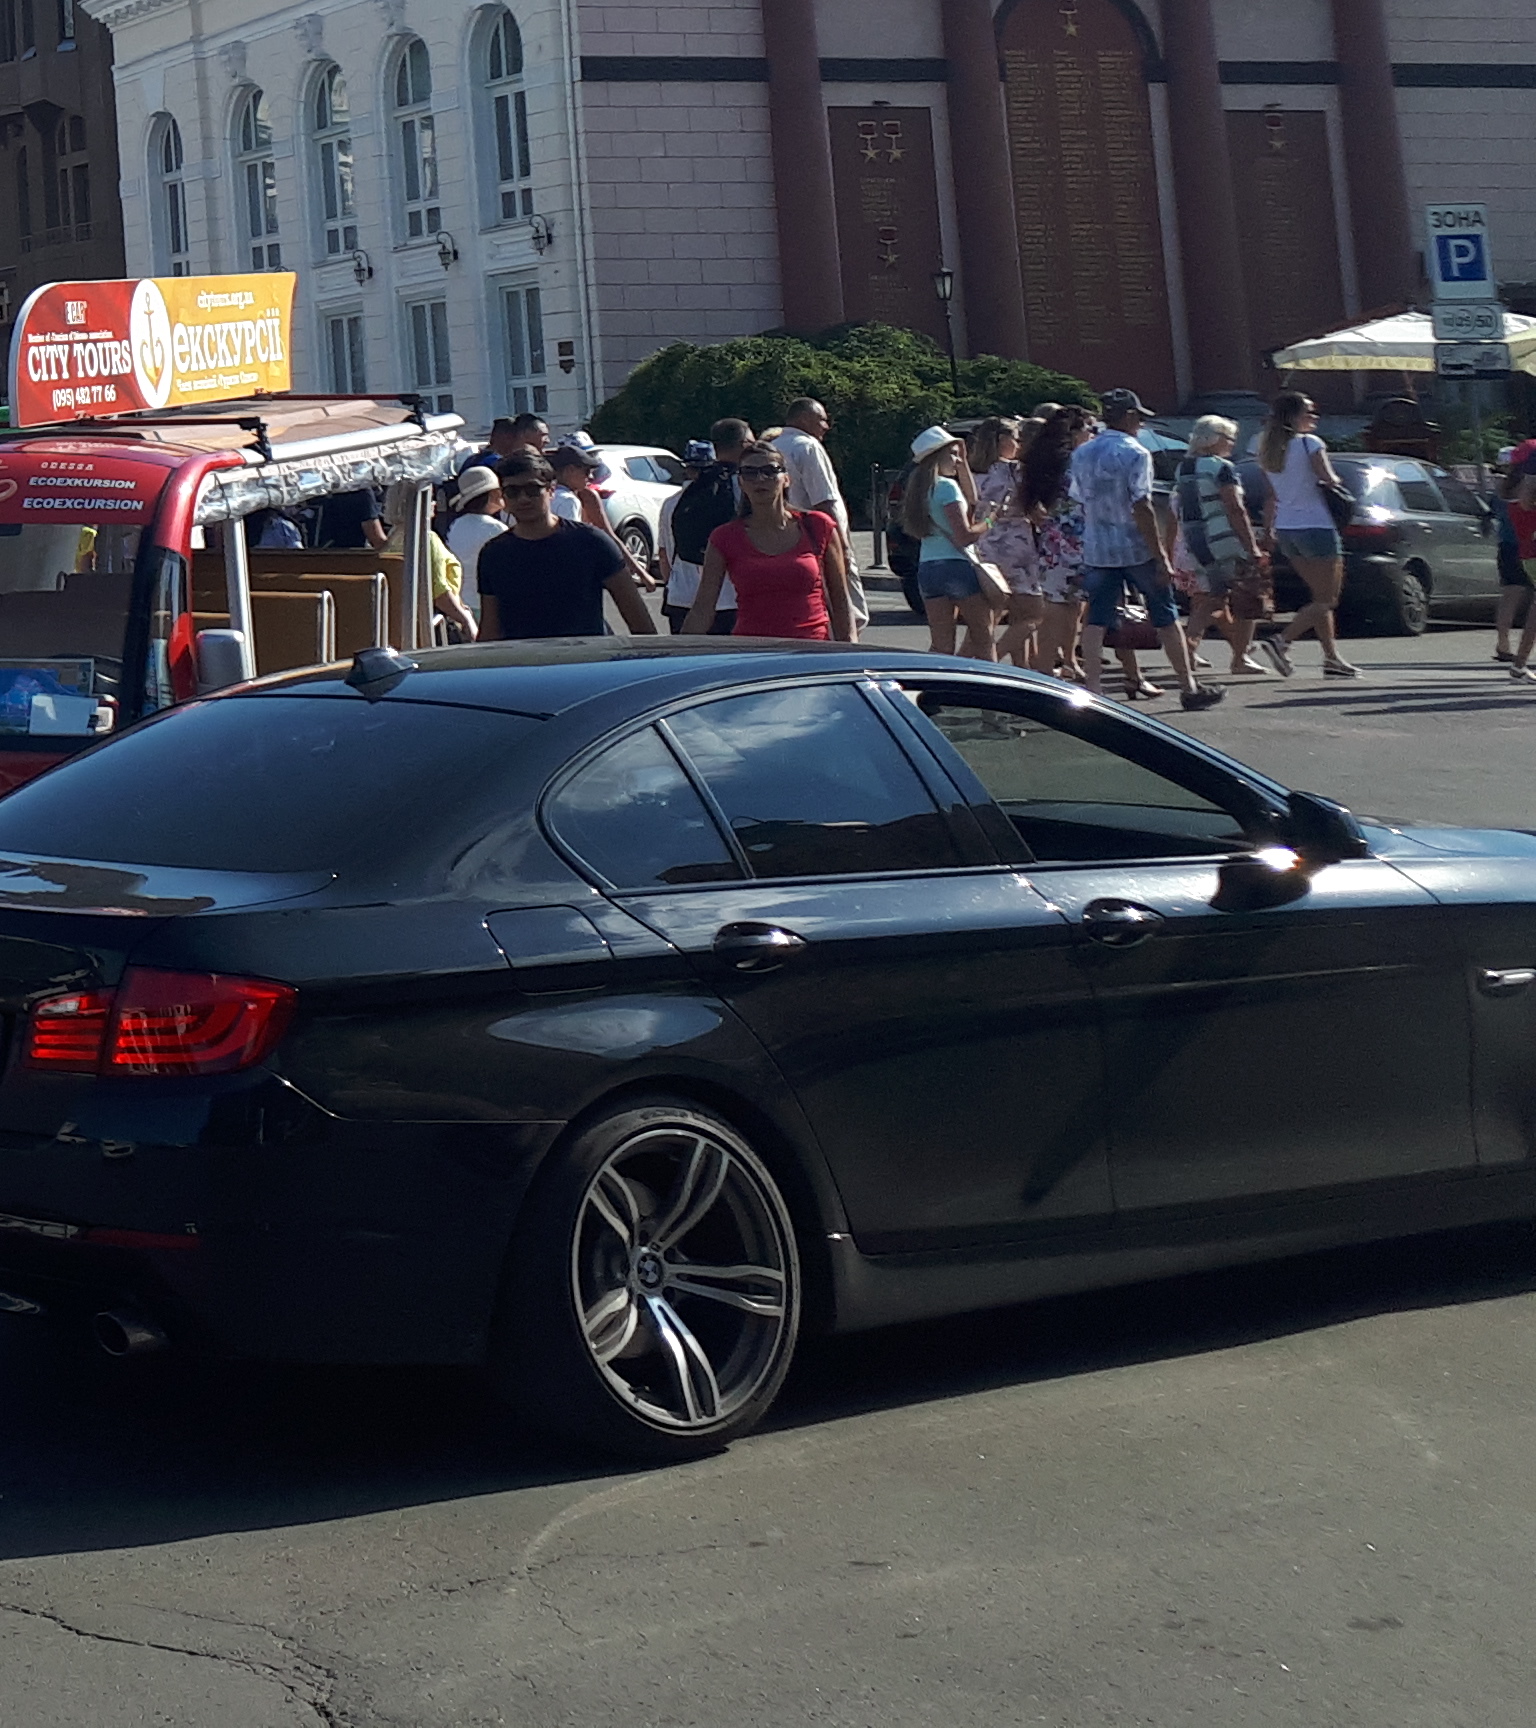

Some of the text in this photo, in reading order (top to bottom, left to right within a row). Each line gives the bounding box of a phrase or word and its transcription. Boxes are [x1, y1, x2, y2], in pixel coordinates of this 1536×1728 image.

[1431, 210, 1486, 229] ЗОНА
[28, 339, 132, 382] CITY TOURS
[91, 385, 102, 403] 77
[104, 384, 116, 402] 66
[28, 476, 137, 489] ECOEXKURSION
[22, 497, 144, 512] ECOEXCURSION
